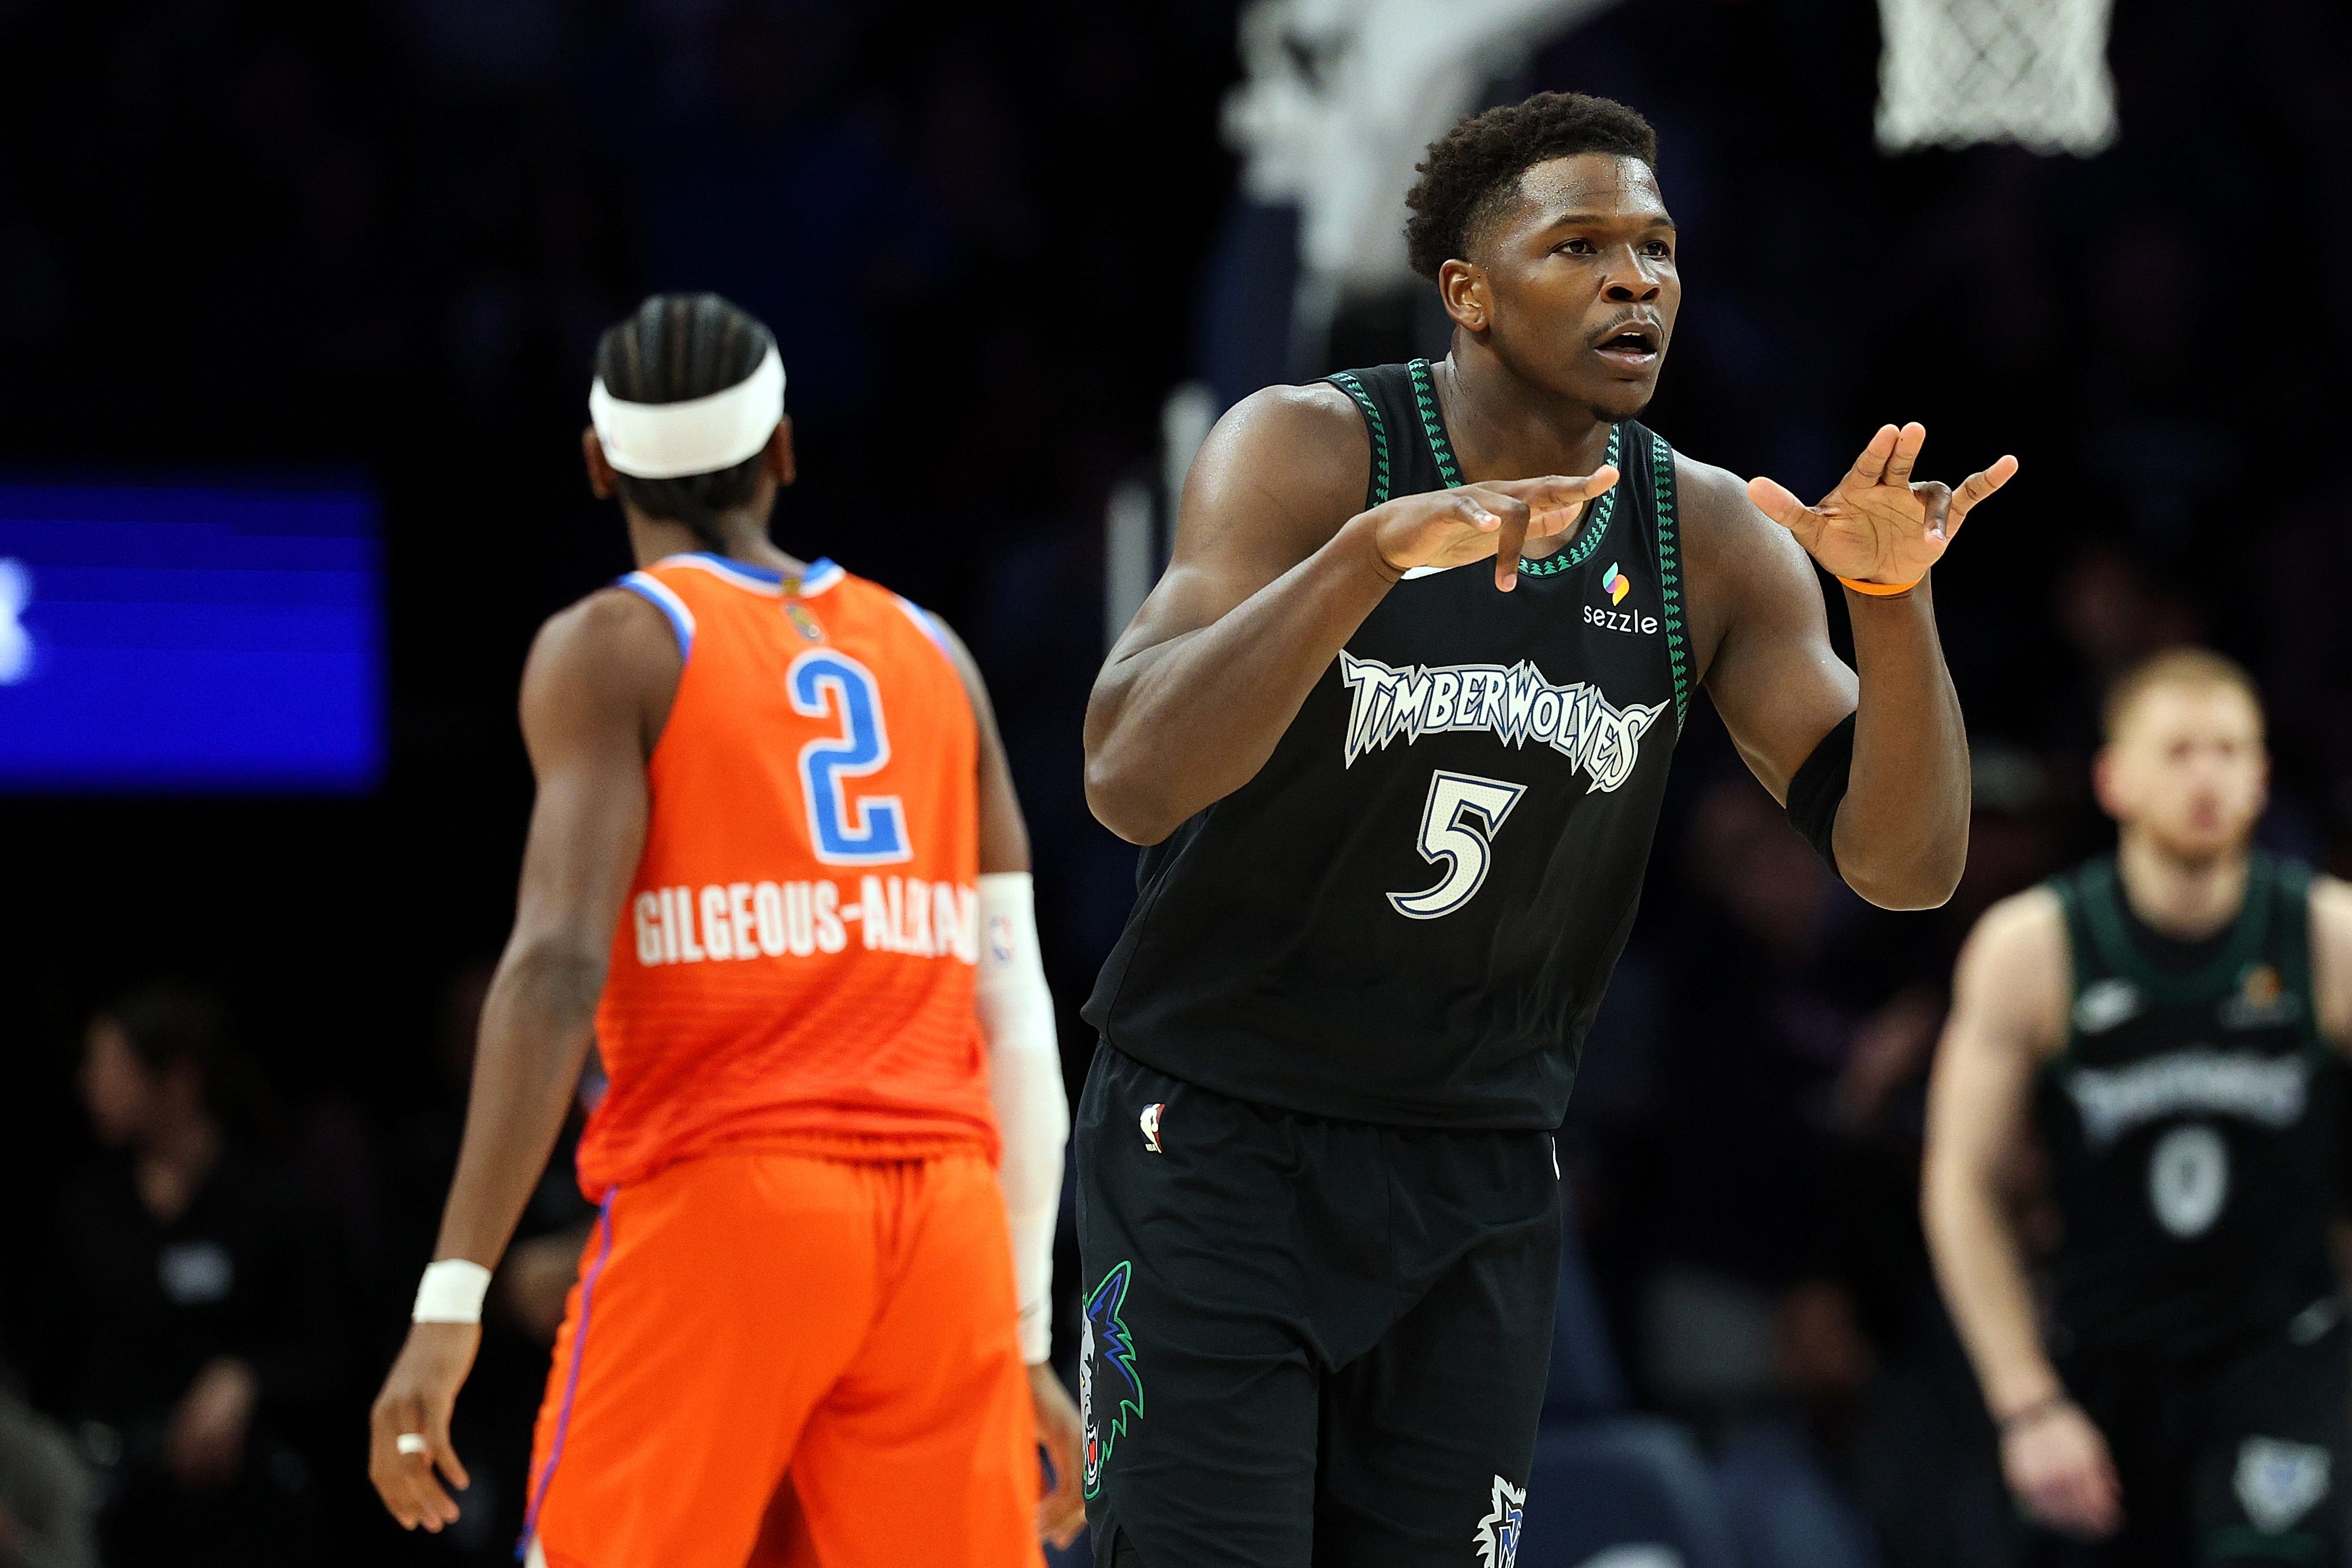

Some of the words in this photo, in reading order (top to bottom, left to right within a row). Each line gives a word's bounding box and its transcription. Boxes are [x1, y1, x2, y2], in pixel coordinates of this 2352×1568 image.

[1583, 605, 1658, 634] sezzle
[786, 647, 913, 866] 2
[1339, 649, 1670, 794] TIMBERWOLVES
[1386, 769, 1528, 919] 5
[2148, 1123, 2230, 1239] 0
